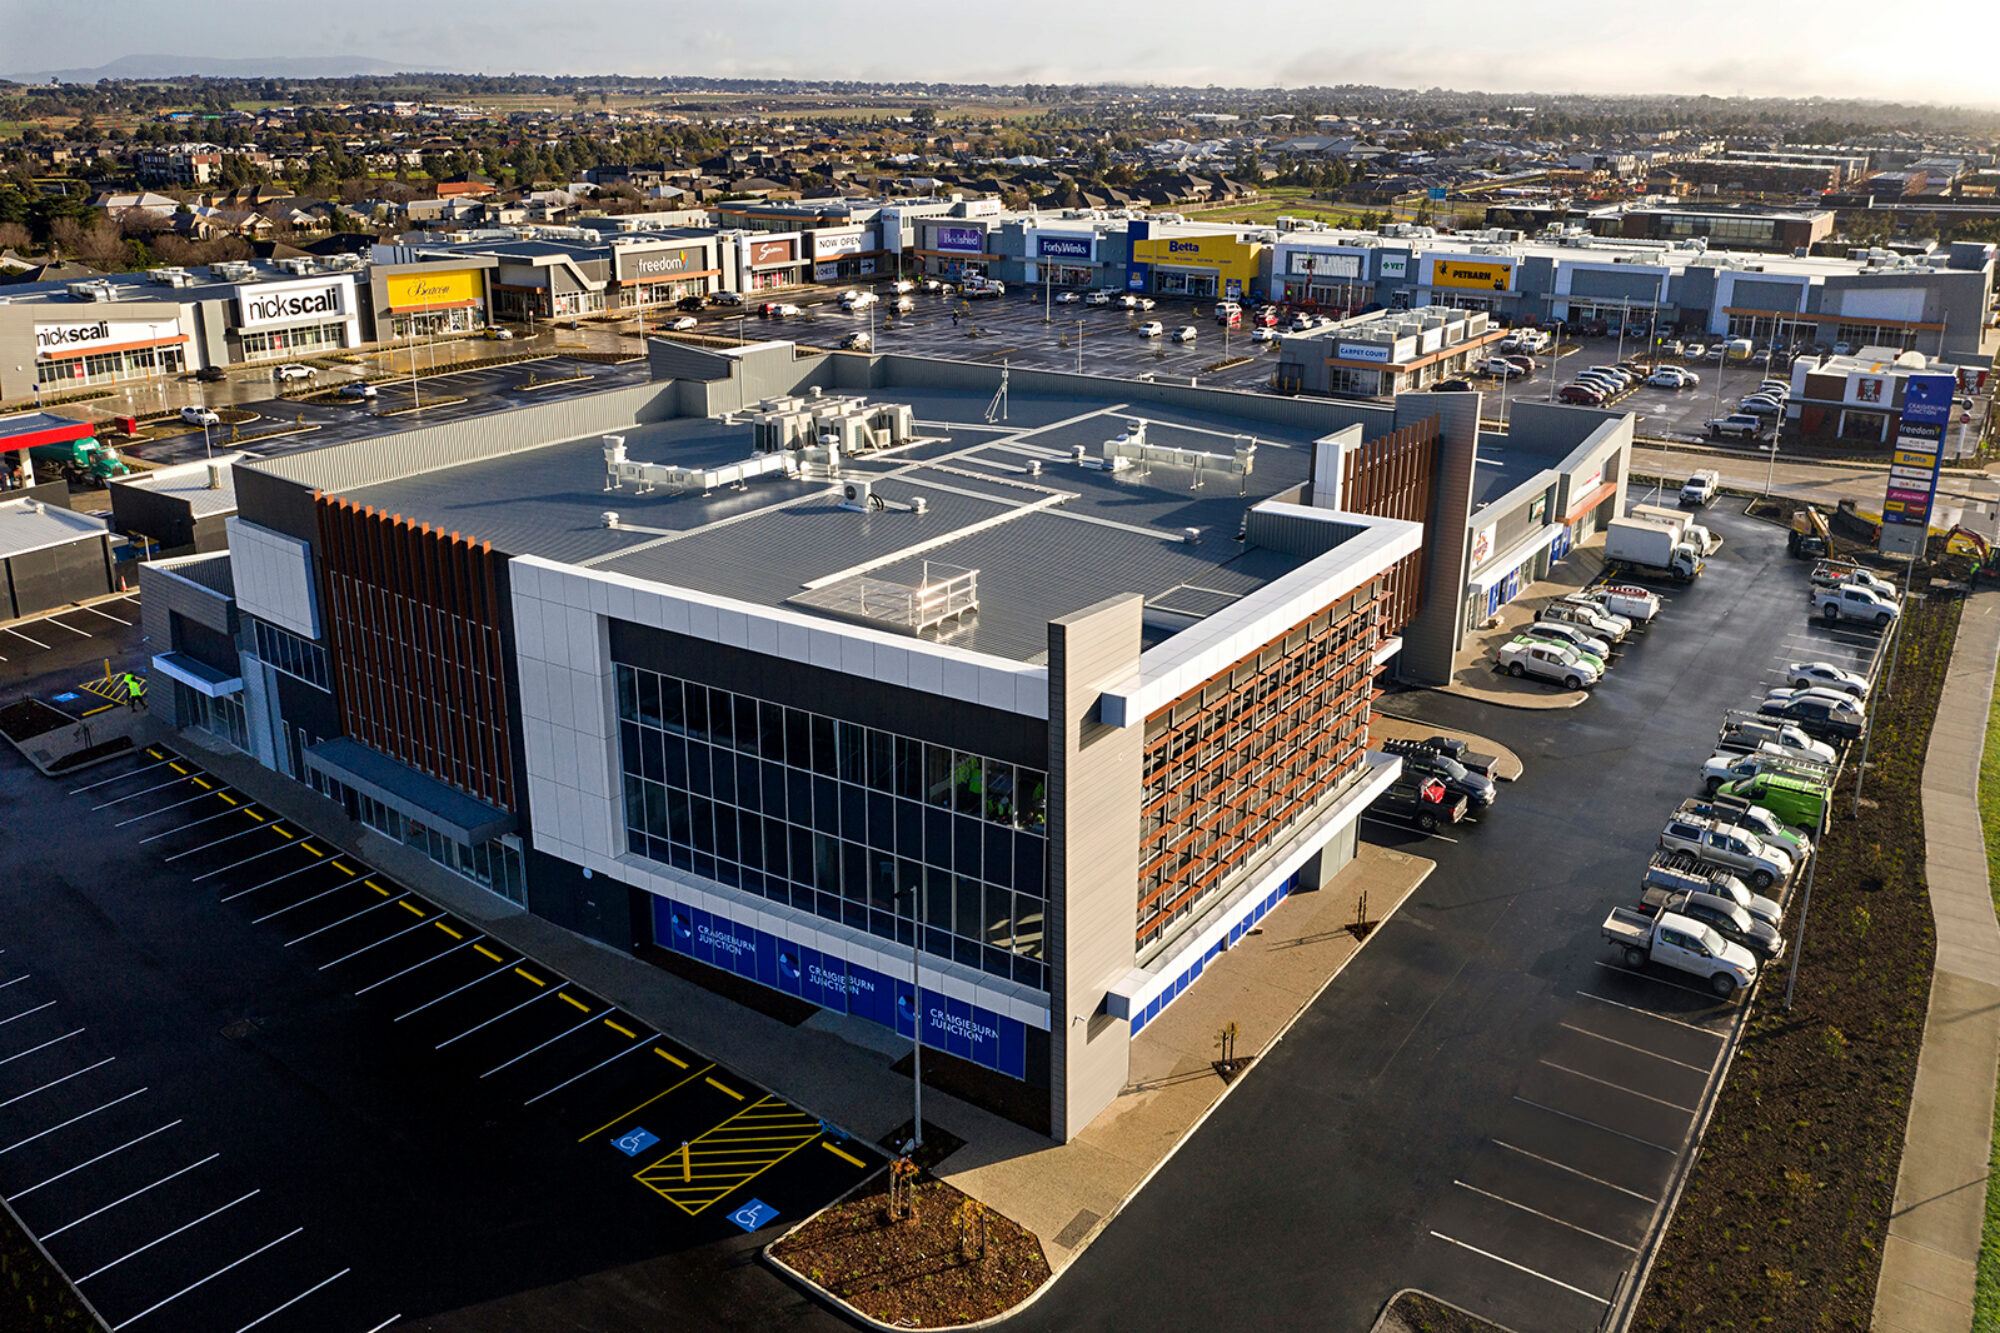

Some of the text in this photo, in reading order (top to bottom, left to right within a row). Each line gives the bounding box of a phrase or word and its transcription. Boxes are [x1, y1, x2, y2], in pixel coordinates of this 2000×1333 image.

[819, 233, 861, 248] NOW OPEN
[943, 232, 978, 245] Bedshed
[1169, 240, 1200, 252] Betta
[638, 256, 683, 273] freedom
[1390, 262, 1405, 271] VET
[1453, 269, 1492, 281] PETBARN
[250, 288, 338, 320] nickscali
[36, 320, 109, 347] nickscali
[1340, 347, 1387, 358] CARPET COURT
[1899, 424, 1935, 435] freedom
[1903, 454, 1927, 463] Betta
[698, 924, 755, 952] CRAIGIEBURN
[699, 934, 742, 956] JUNCTION
[808, 964, 875, 992] CRAIGIEBURN
[809, 974, 859, 996] JUNCTION
[930, 1008, 998, 1039] CRAIGIEBURN
[930, 1018, 983, 1044] JUNCTION
